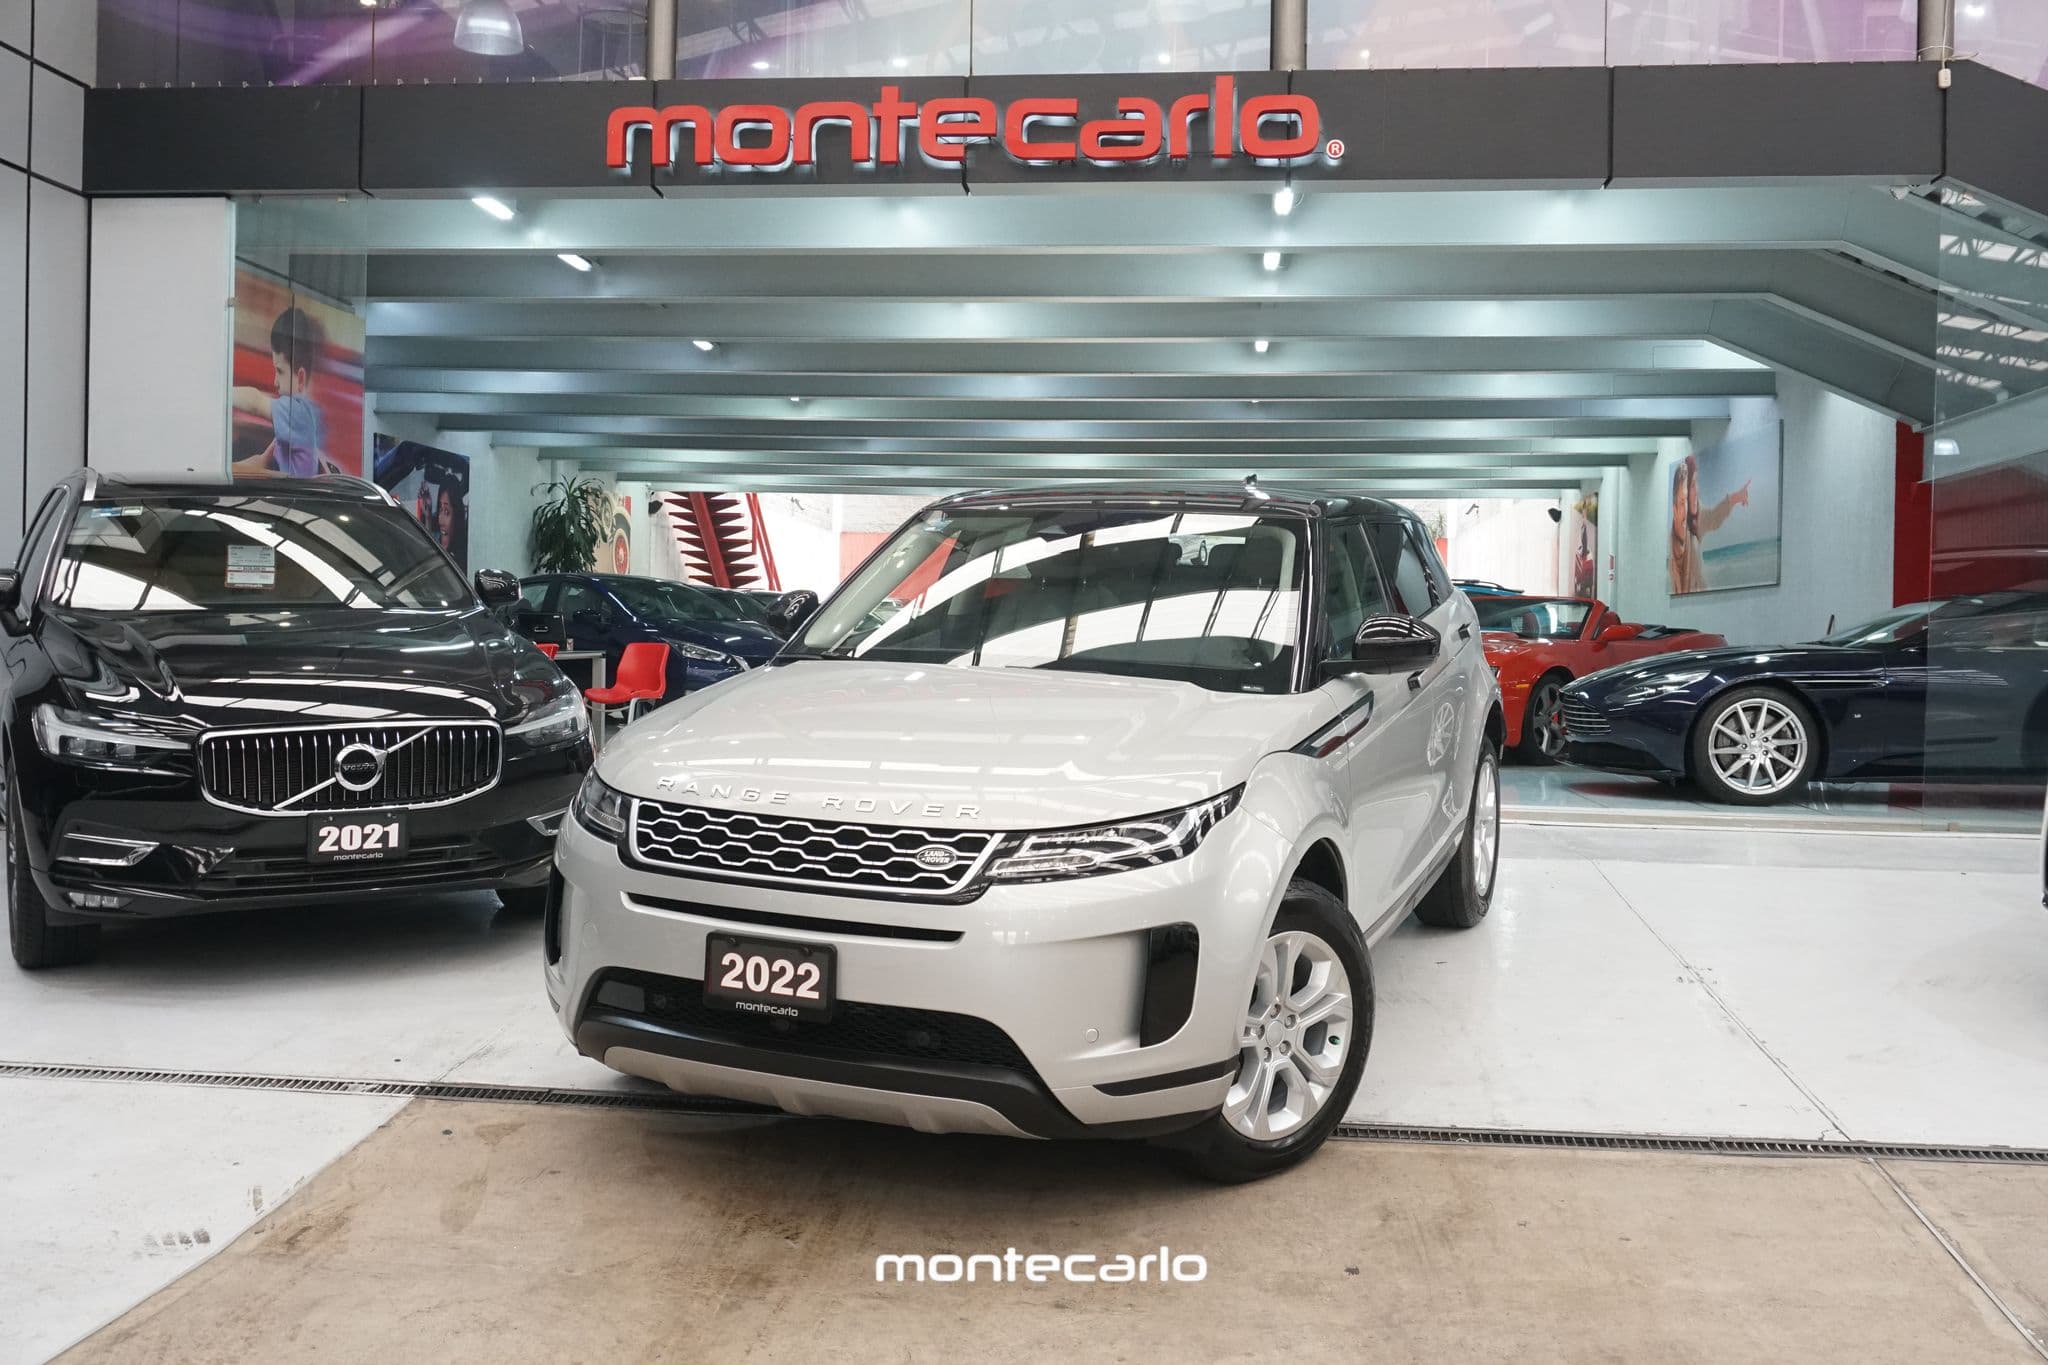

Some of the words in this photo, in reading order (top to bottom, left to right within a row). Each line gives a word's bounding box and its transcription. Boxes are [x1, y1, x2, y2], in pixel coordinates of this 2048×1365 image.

[606, 75, 1320, 167] montecarlo
[656, 776, 790, 804] RANGE
[822, 793, 981, 819] ROVER
[318, 823, 399, 852] 2021
[333, 852, 384, 861] montecarlo
[720, 952, 820, 999] 2022
[735, 1001, 799, 1017] montecarlo
